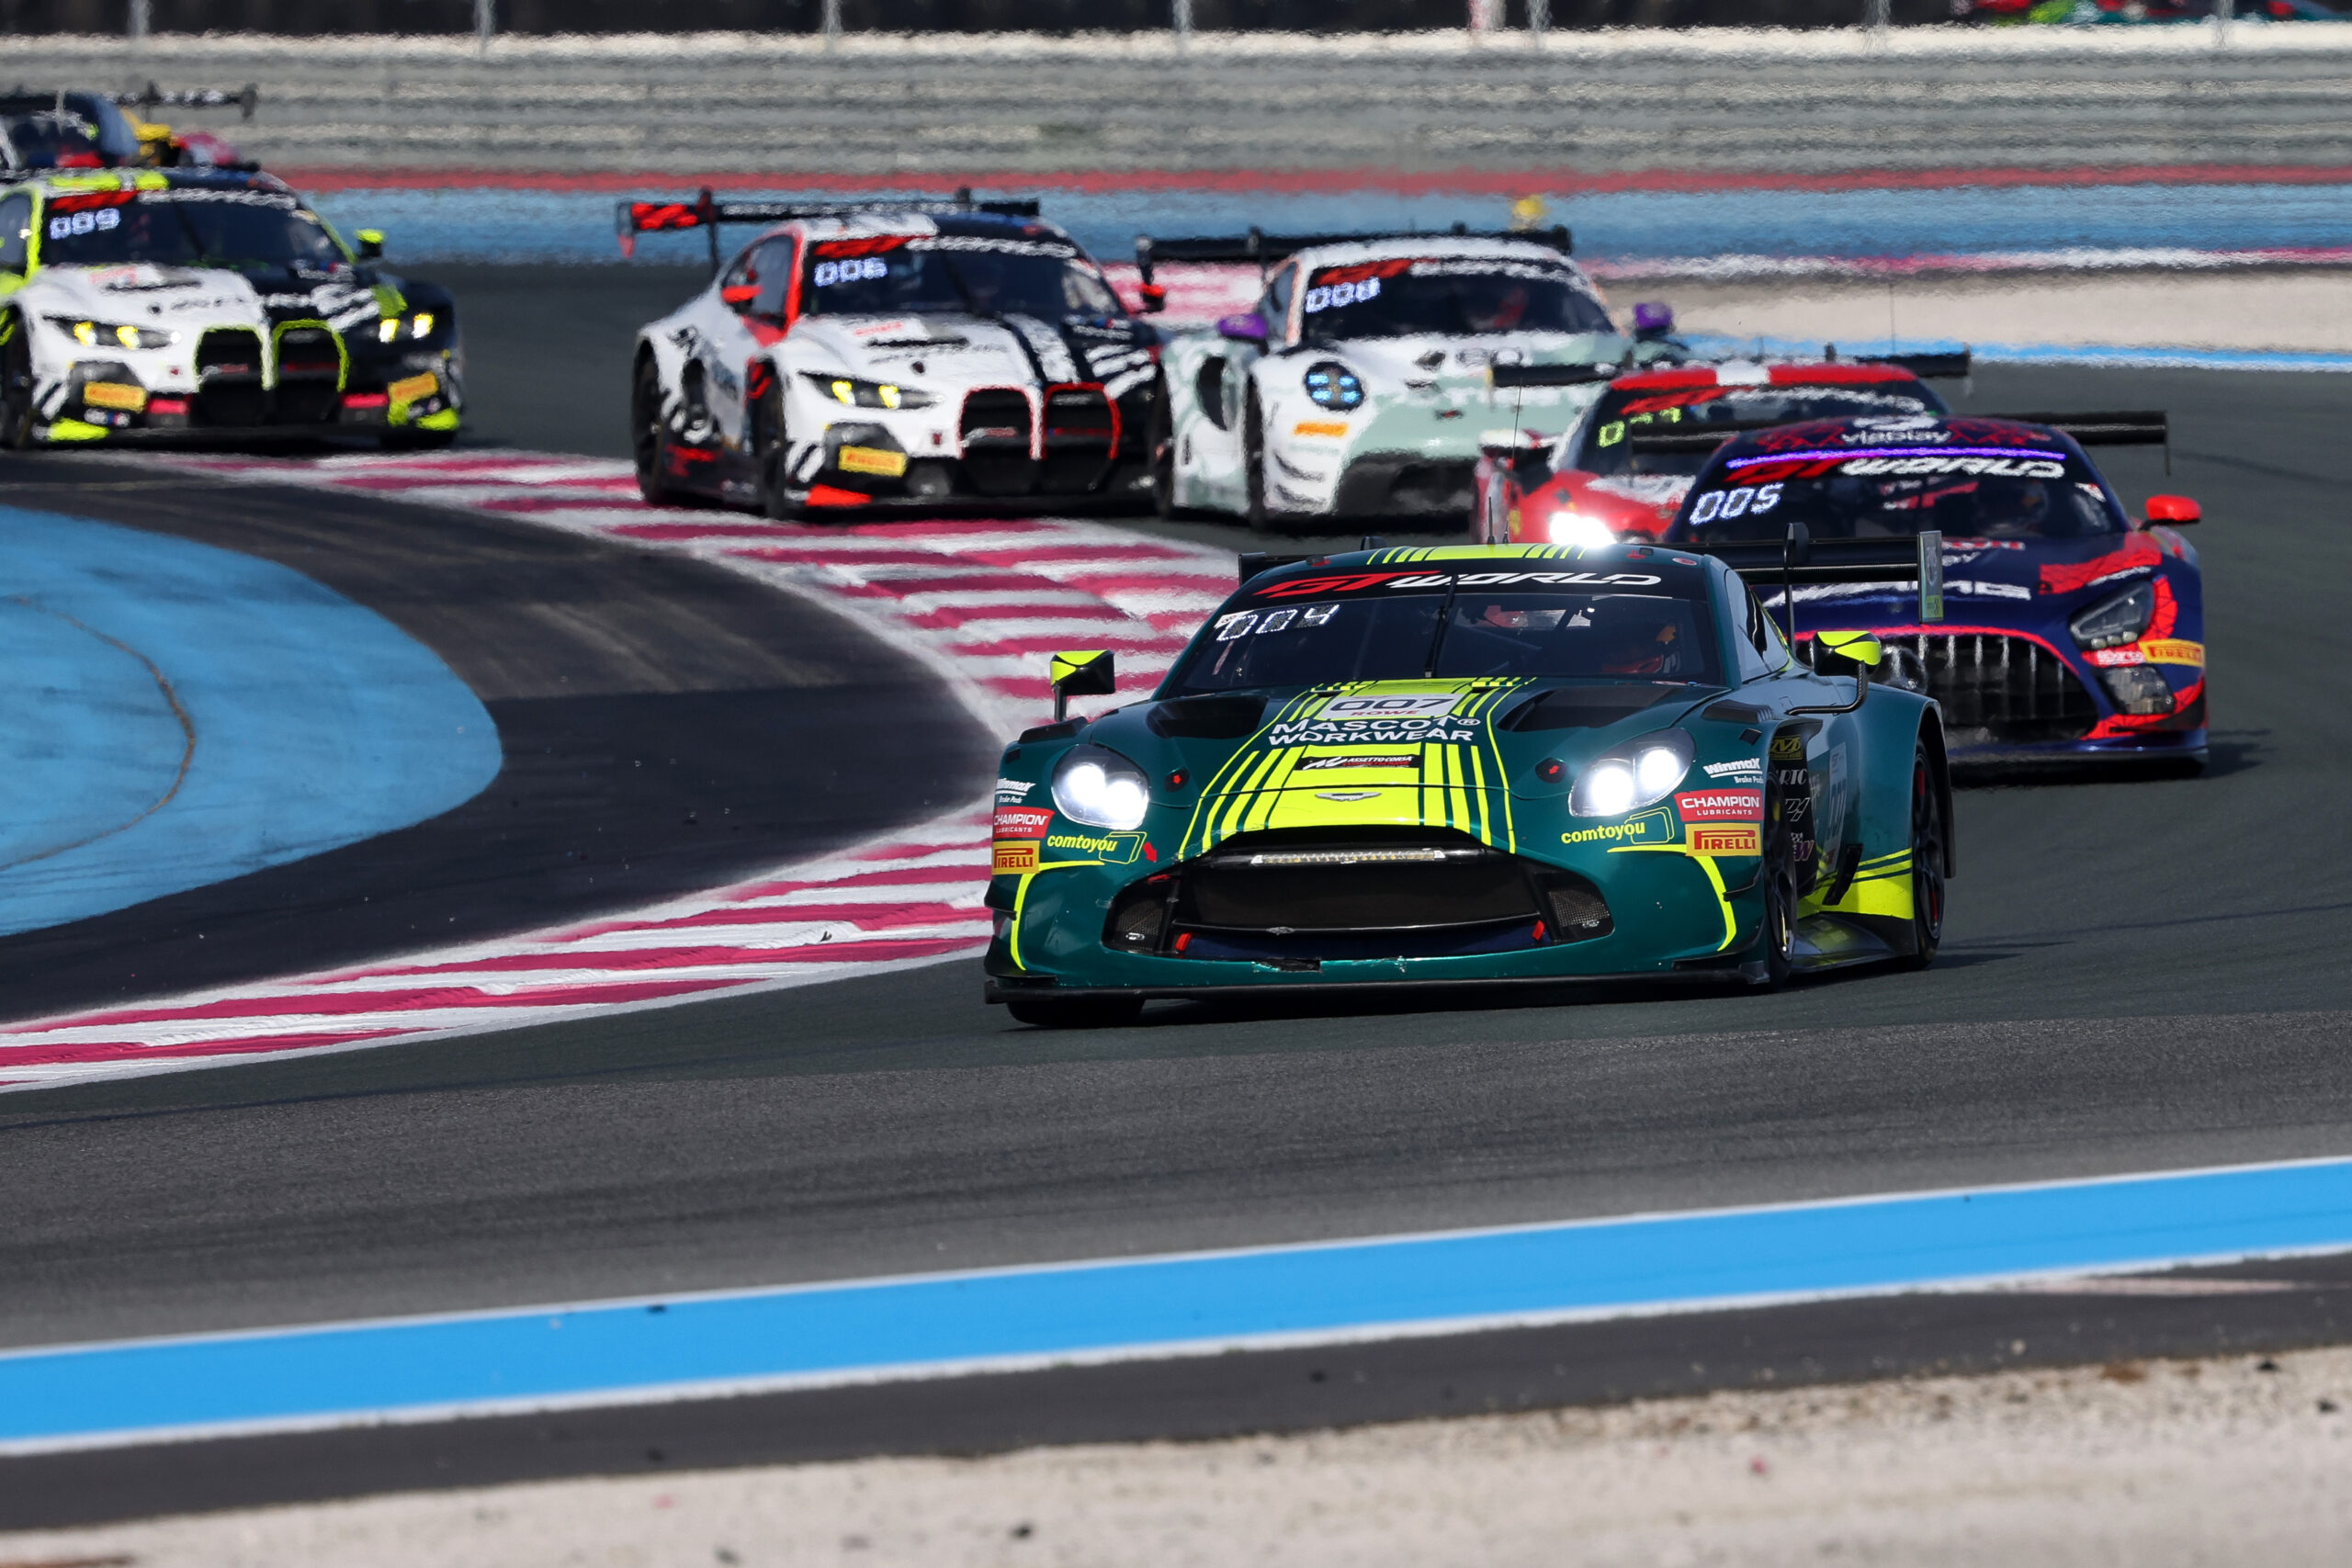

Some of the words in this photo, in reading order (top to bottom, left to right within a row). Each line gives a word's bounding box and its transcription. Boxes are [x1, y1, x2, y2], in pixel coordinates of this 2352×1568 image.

[1689, 482, 1785, 526] 005
[1385, 572, 1662, 590] WORLD
[1216, 604, 1340, 642] 004
[1330, 698, 1454, 711] 007
[1269, 728, 1475, 746] WORKWEAR
[1680, 795, 1760, 809] CHAMPION
[994, 814, 1048, 826] CHAMPION
[1561, 821, 1645, 844] comtoyou
[1693, 829, 1757, 851] PIRELLI
[1046, 834, 1118, 853] comtoyou
[994, 848, 1034, 869] PIRELLI
